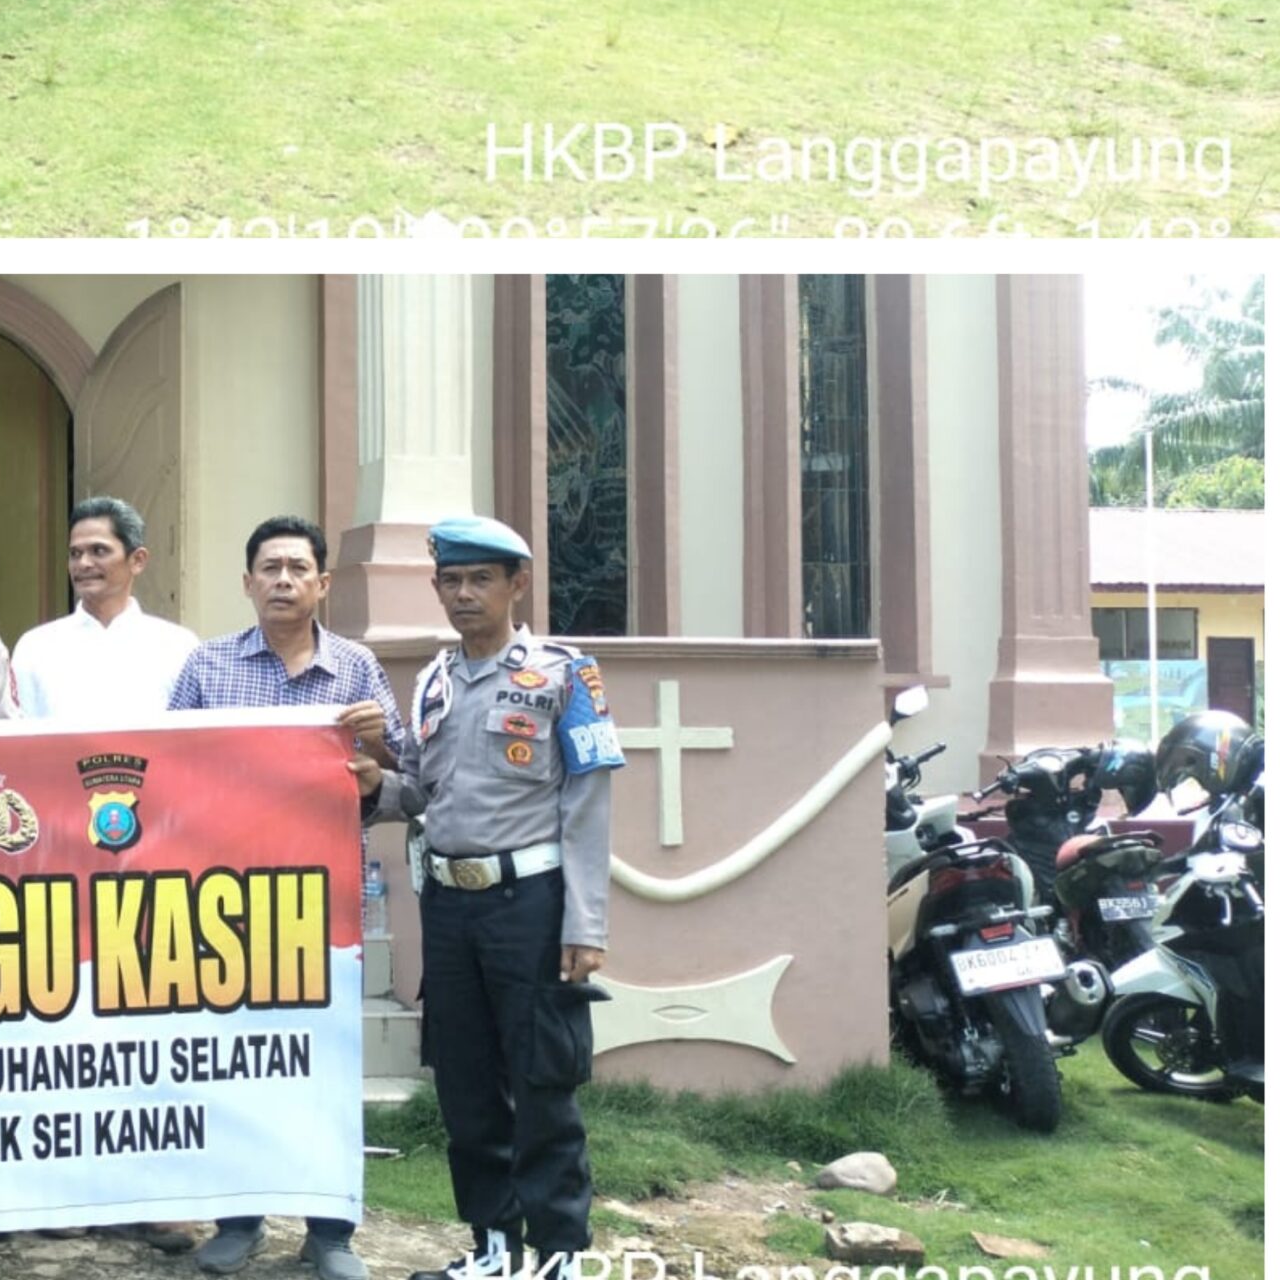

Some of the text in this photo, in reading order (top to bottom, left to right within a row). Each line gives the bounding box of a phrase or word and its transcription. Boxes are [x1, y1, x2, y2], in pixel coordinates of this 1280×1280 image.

[496, 690, 554, 711] POLRI
[82, 754, 142, 769] POLRES
[91, 866, 330, 1017] KASIH
[171, 1033, 310, 1083] SELATAN
[33, 1112, 82, 1161] SEI
[95, 1105, 205, 1155] KANAN
